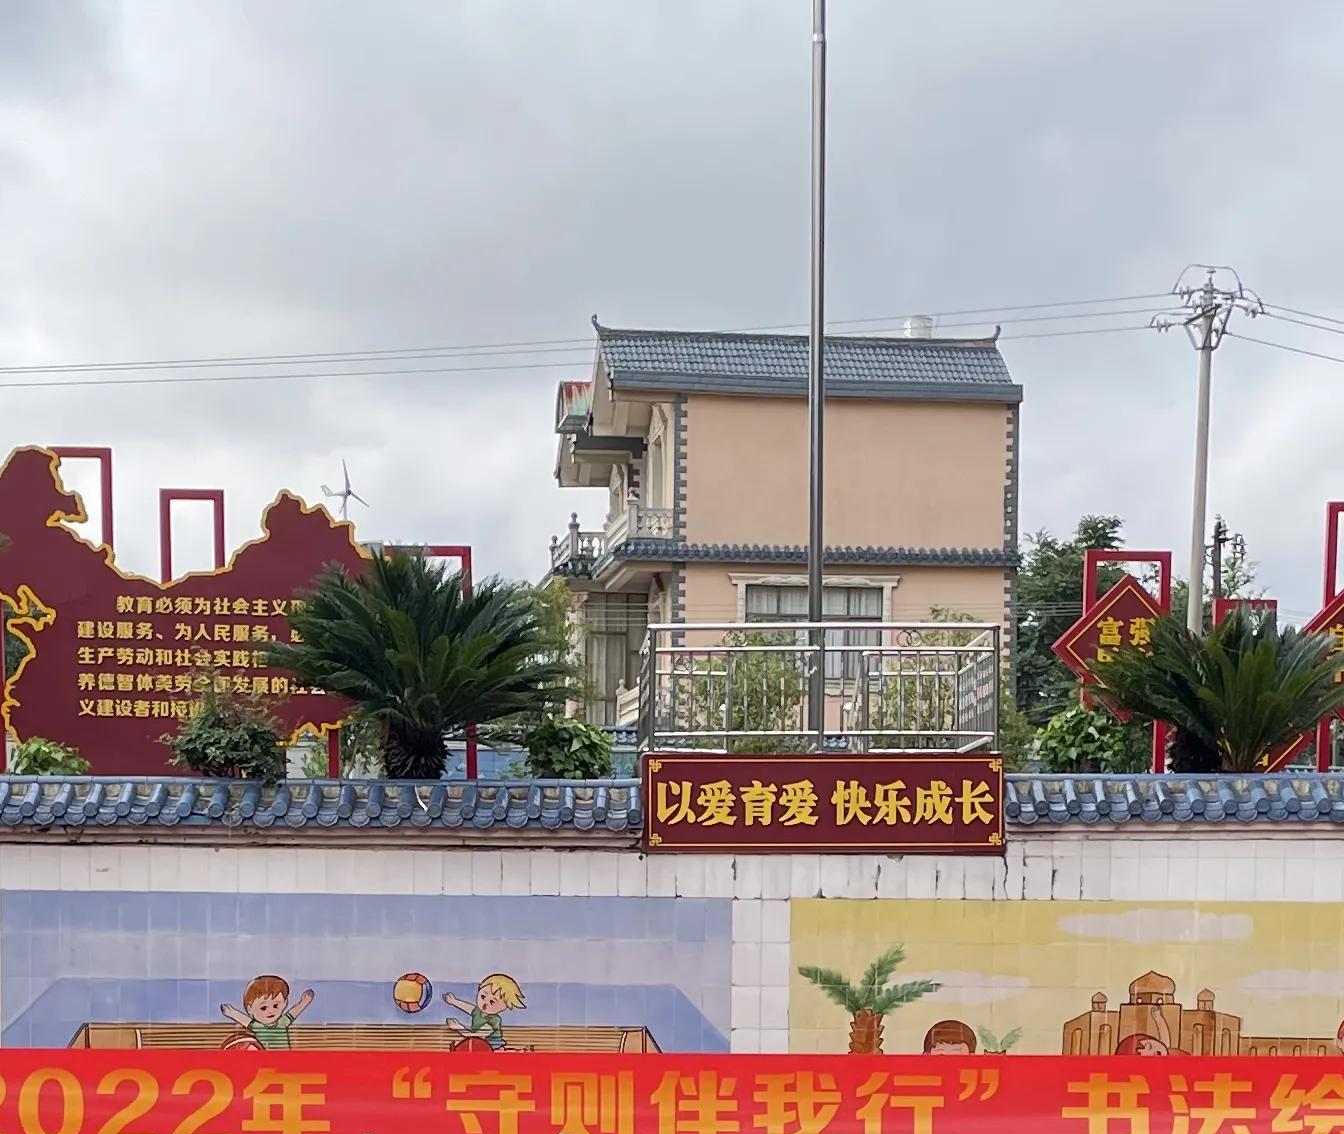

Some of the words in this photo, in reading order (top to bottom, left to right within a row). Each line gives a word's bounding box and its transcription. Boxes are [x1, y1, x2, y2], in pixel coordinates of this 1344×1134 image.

[656, 779, 818, 827] 以爱育爱
[832, 779, 995, 827] 快乐成长
